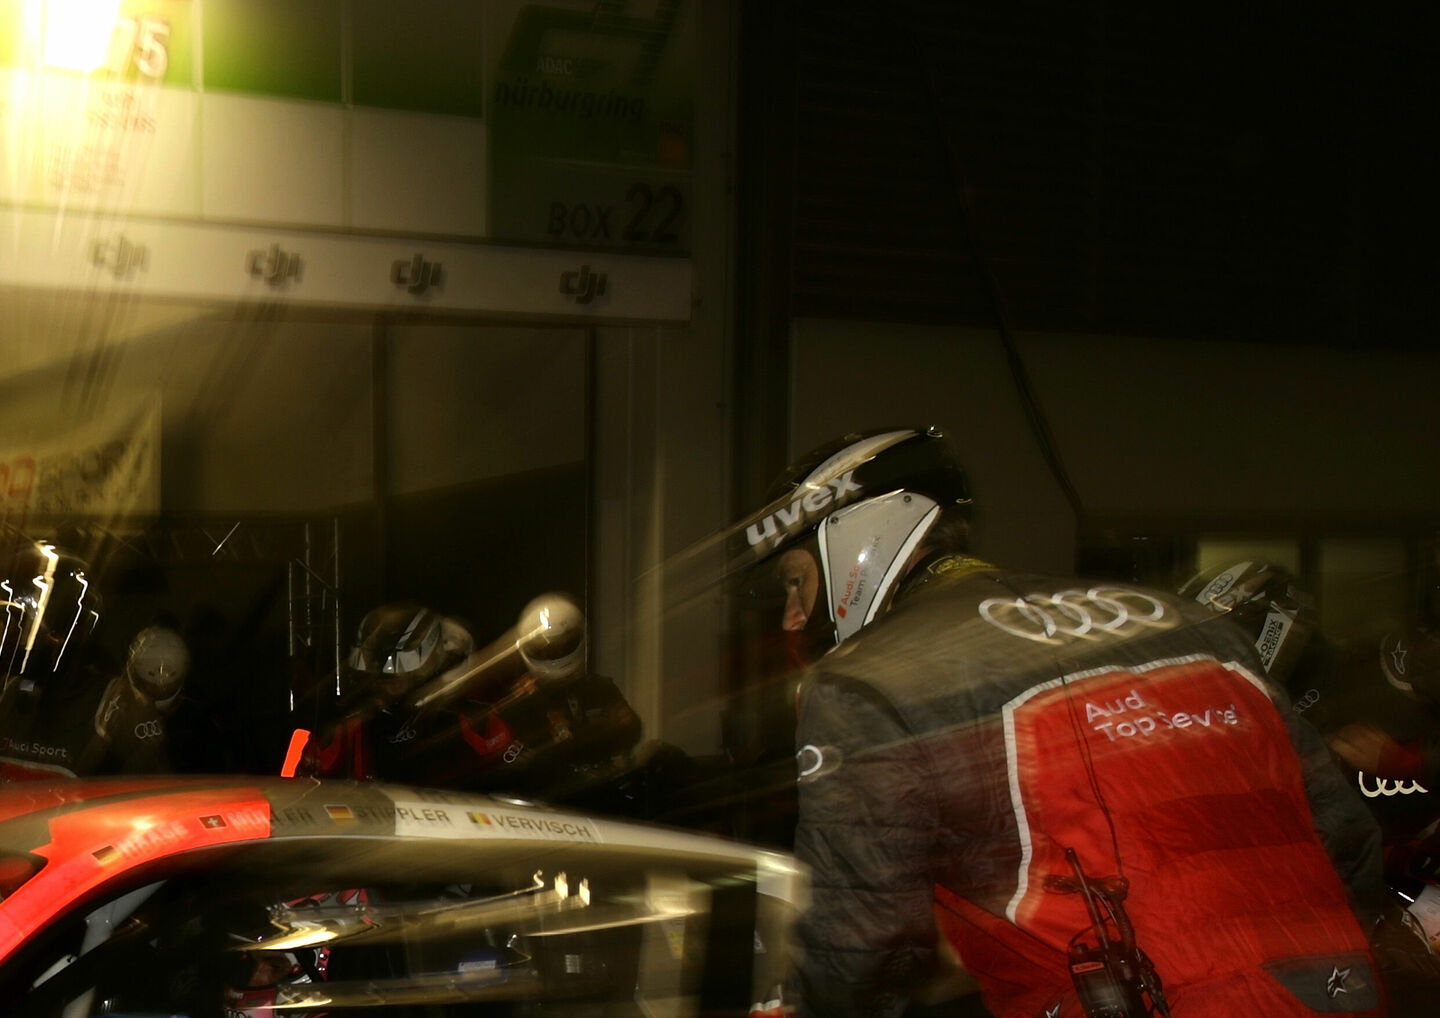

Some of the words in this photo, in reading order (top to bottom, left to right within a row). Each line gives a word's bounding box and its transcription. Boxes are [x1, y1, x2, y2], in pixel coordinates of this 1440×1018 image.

[536, 55, 573, 75] ADAC
[548, 202, 613, 240] BOX
[622, 182, 683, 243] 22
[747, 470, 863, 547] uvex
[1085, 689, 1147, 723] Aud
[1094, 716, 1156, 742] Top
[31, 743, 67, 758] Sport
[355, 806, 451, 828] STIPPLER
[493, 813, 591, 841] VERVISCH
